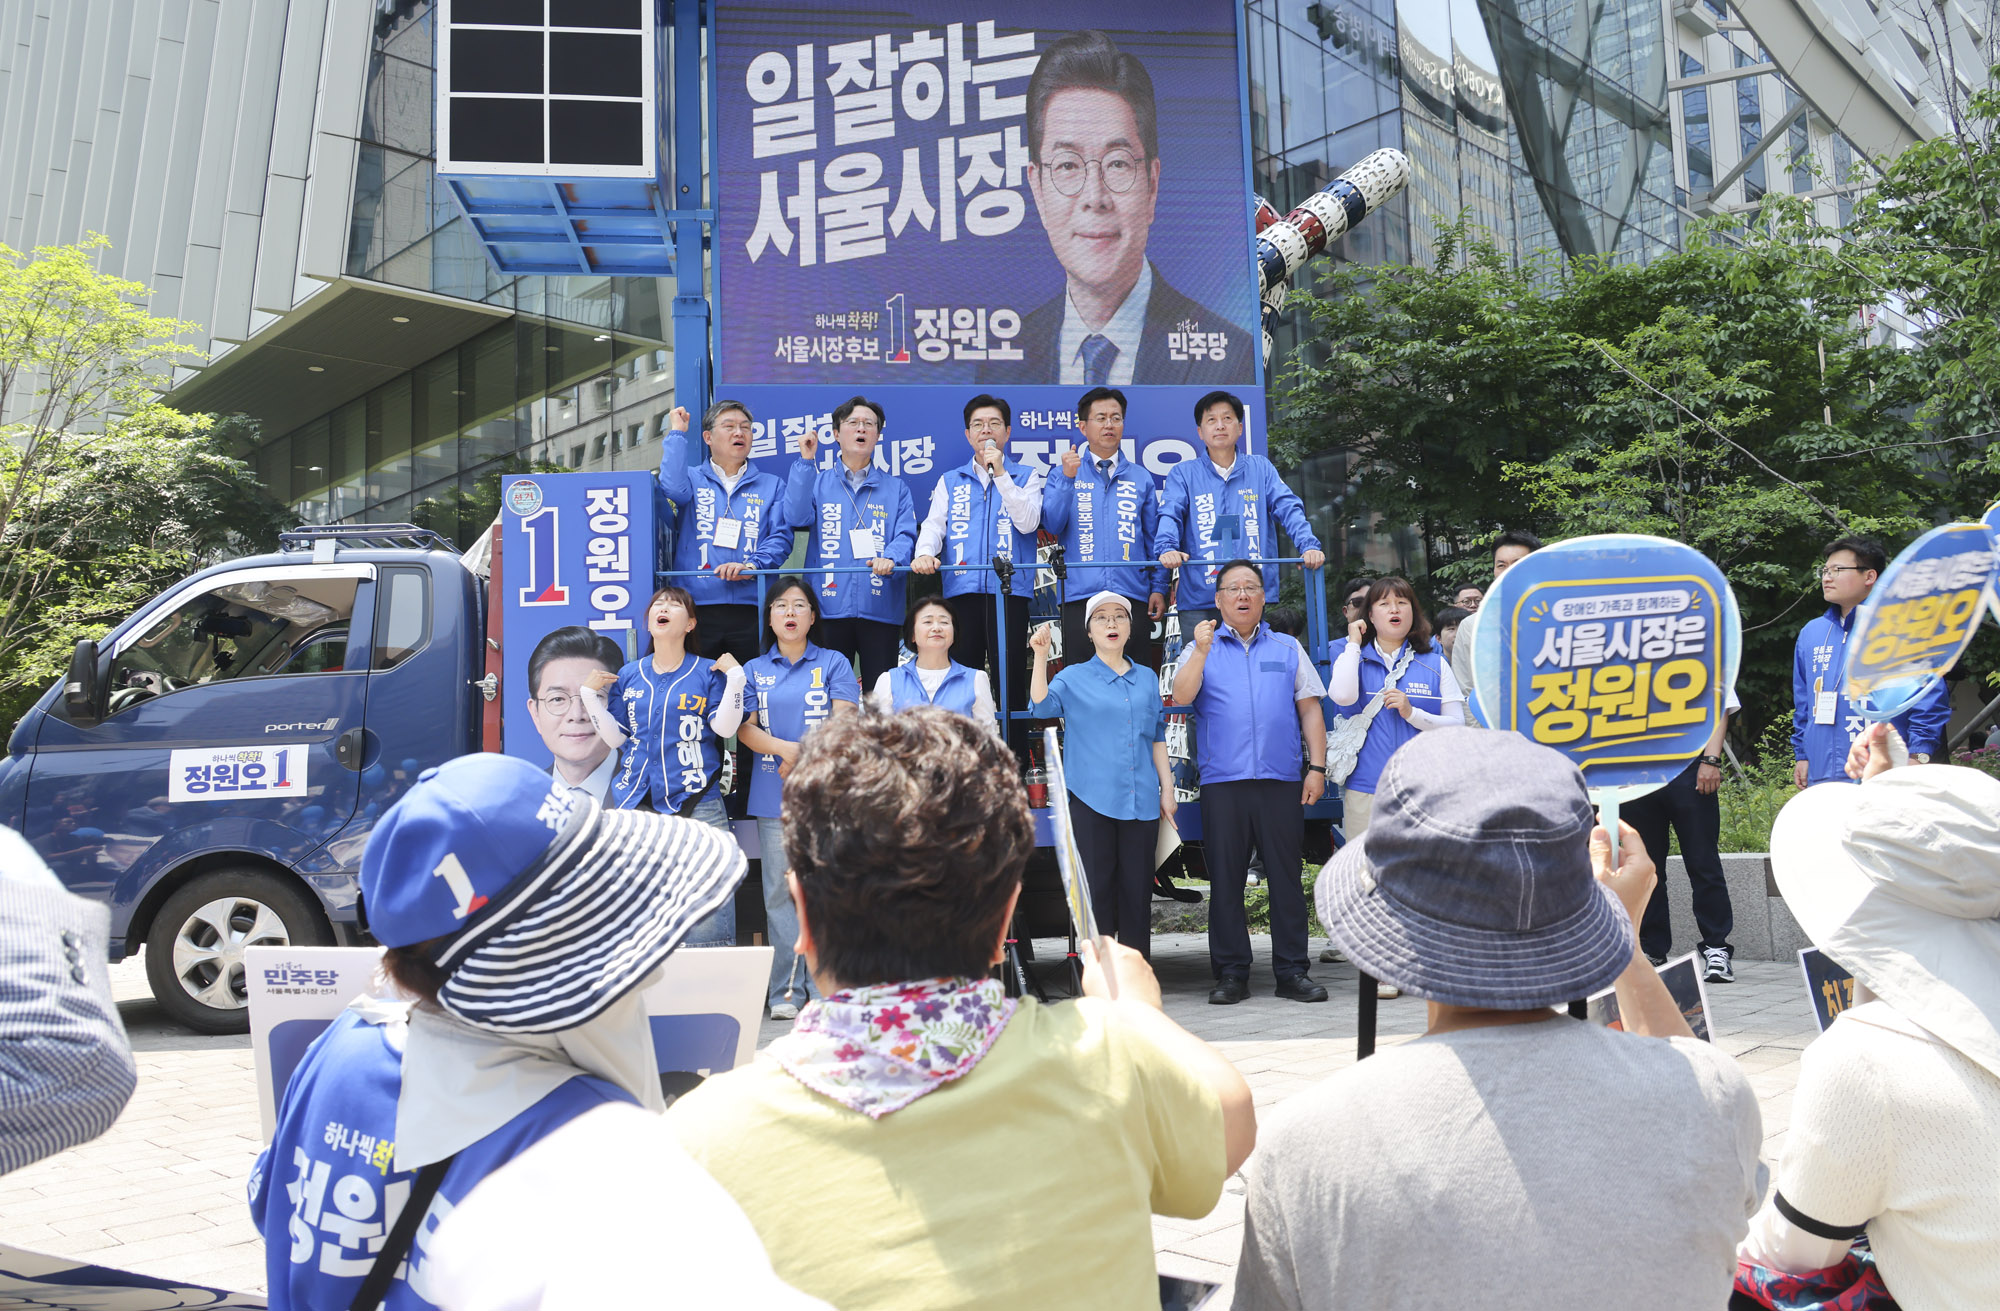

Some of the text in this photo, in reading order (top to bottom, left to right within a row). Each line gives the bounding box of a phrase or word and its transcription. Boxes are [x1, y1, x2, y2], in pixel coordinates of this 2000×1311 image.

[745, 19, 1041, 159] 일 잘하는
[745, 125, 1030, 267] 서울시장
[815, 311, 879, 331] 하나씩 착착!
[886, 294, 910, 364] 1
[913, 308, 1024, 362] 정원오
[1168, 332, 1228, 361] 민주당
[1020, 411, 1071, 430] 하나씩
[696, 488, 716, 540] 정원오
[820, 503, 842, 559] 정원오
[950, 484, 971, 540] 정원오
[1116, 479, 1137, 561] 조유진 1
[1194, 493, 1219, 549] 정원오
[520, 506, 569, 607] 1
[585, 487, 633, 631] 정원오
[1563, 594, 1681, 617] 장애인 가족과 함께하는
[1861, 589, 1980, 665] 정원오
[1532, 615, 1706, 668] 서울시장은
[677, 693, 707, 715] 1-가
[810, 667, 824, 689] 1
[1527, 658, 1708, 744] 정원오
[184, 747, 293, 794] 정원오 1
[212, 754, 236, 762] 하나씩
[433, 852, 489, 920] 1
[264, 969, 339, 986] 민주당
[324, 1121, 375, 1165] 하나씩
